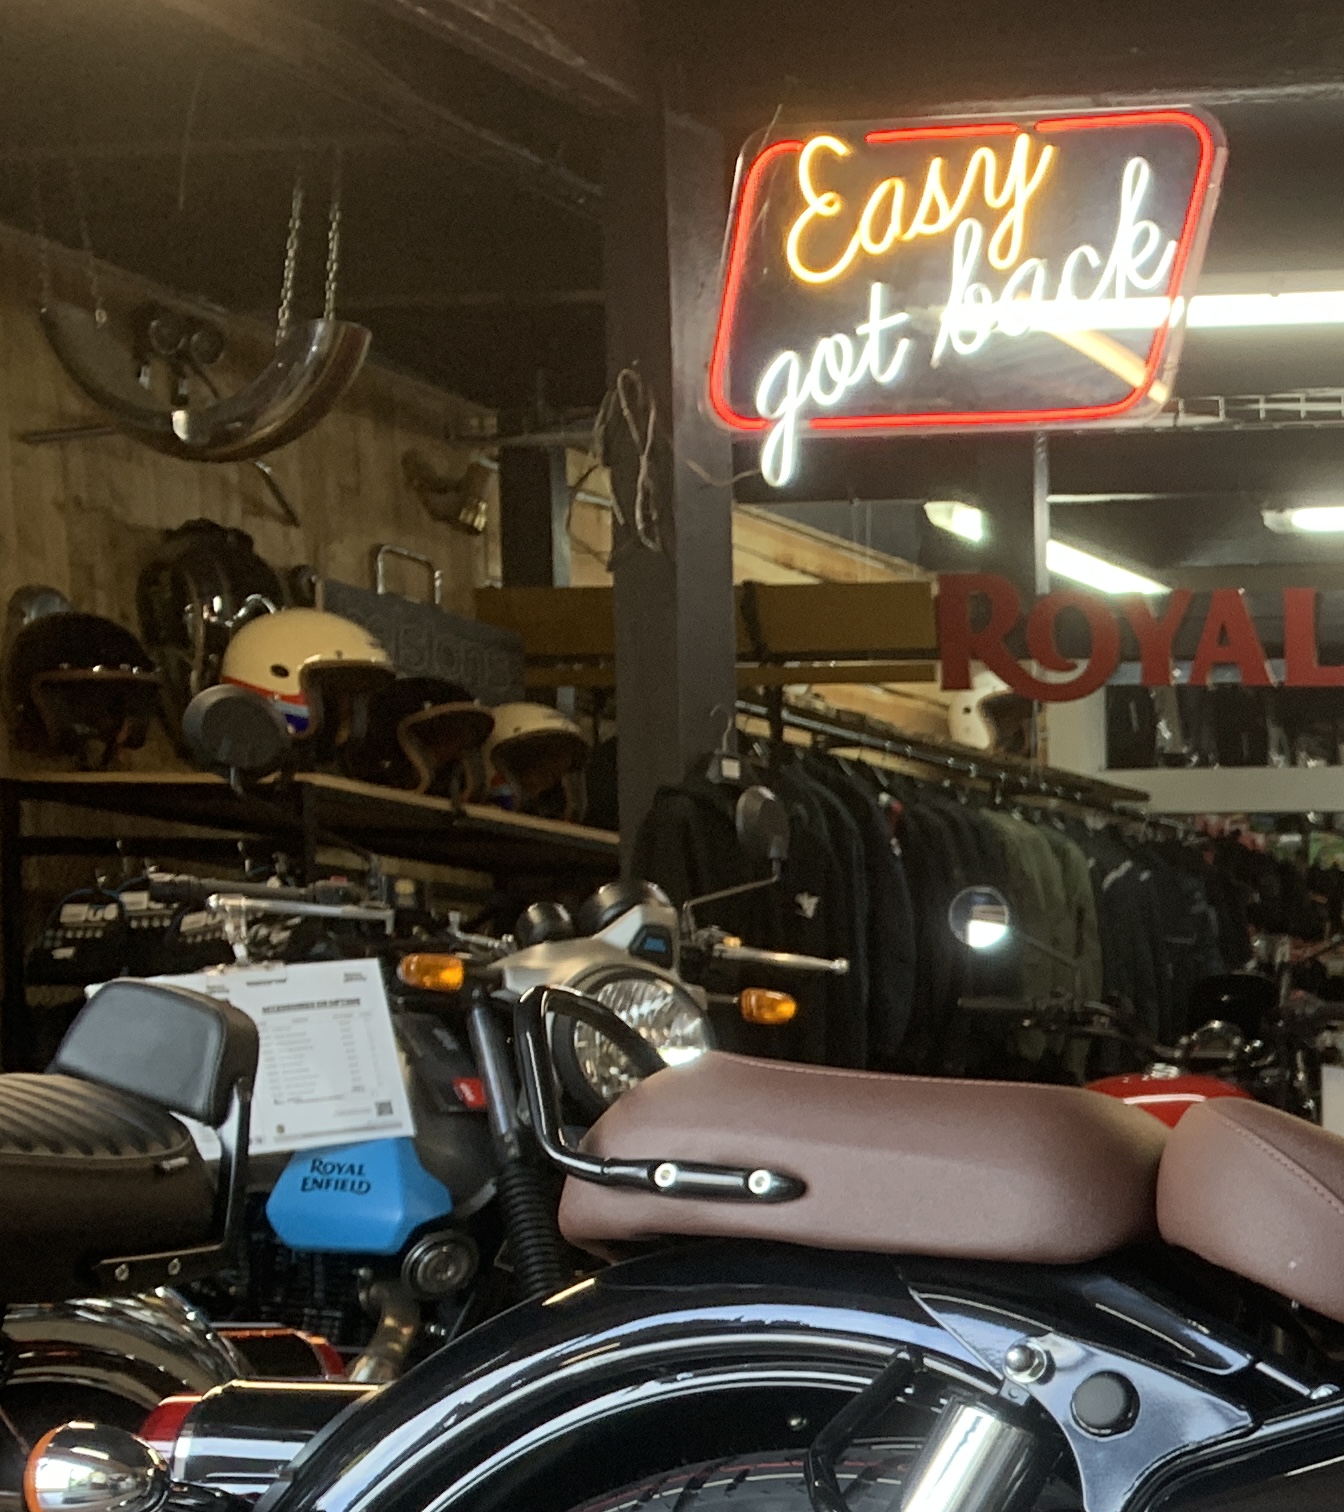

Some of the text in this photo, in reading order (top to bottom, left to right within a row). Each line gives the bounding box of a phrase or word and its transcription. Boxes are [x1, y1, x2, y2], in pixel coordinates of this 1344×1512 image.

[785, 132, 1055, 285] Easy
[754, 156, 1178, 488] got back
[300, 1176, 372, 1195] ENFIELD
[310, 1158, 366, 1177] ROYAL
